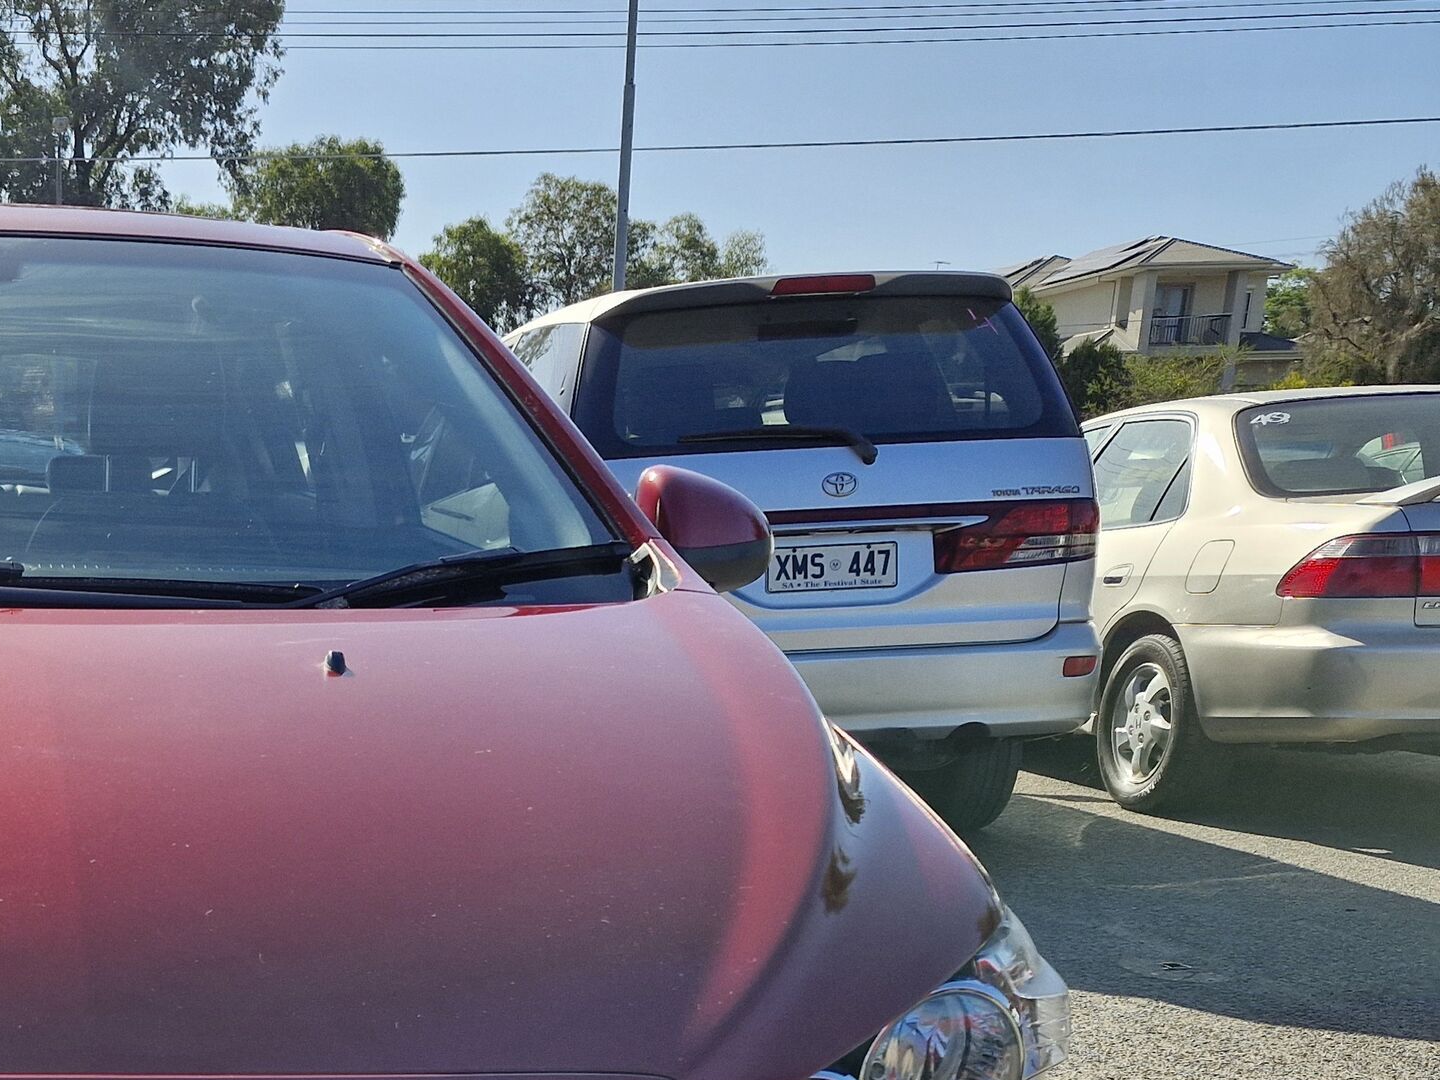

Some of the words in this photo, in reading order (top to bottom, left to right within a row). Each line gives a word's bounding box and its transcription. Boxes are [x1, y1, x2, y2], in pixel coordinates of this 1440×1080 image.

[991, 488, 1020, 497] TOYOTA
[1021, 485, 1080, 495] TARAGO
[775, 552, 825, 581] XMS
[848, 549, 891, 577] 447
[782, 581, 794, 589] SA
[804, 580, 820, 588] The
[823, 578, 857, 587] Festival
